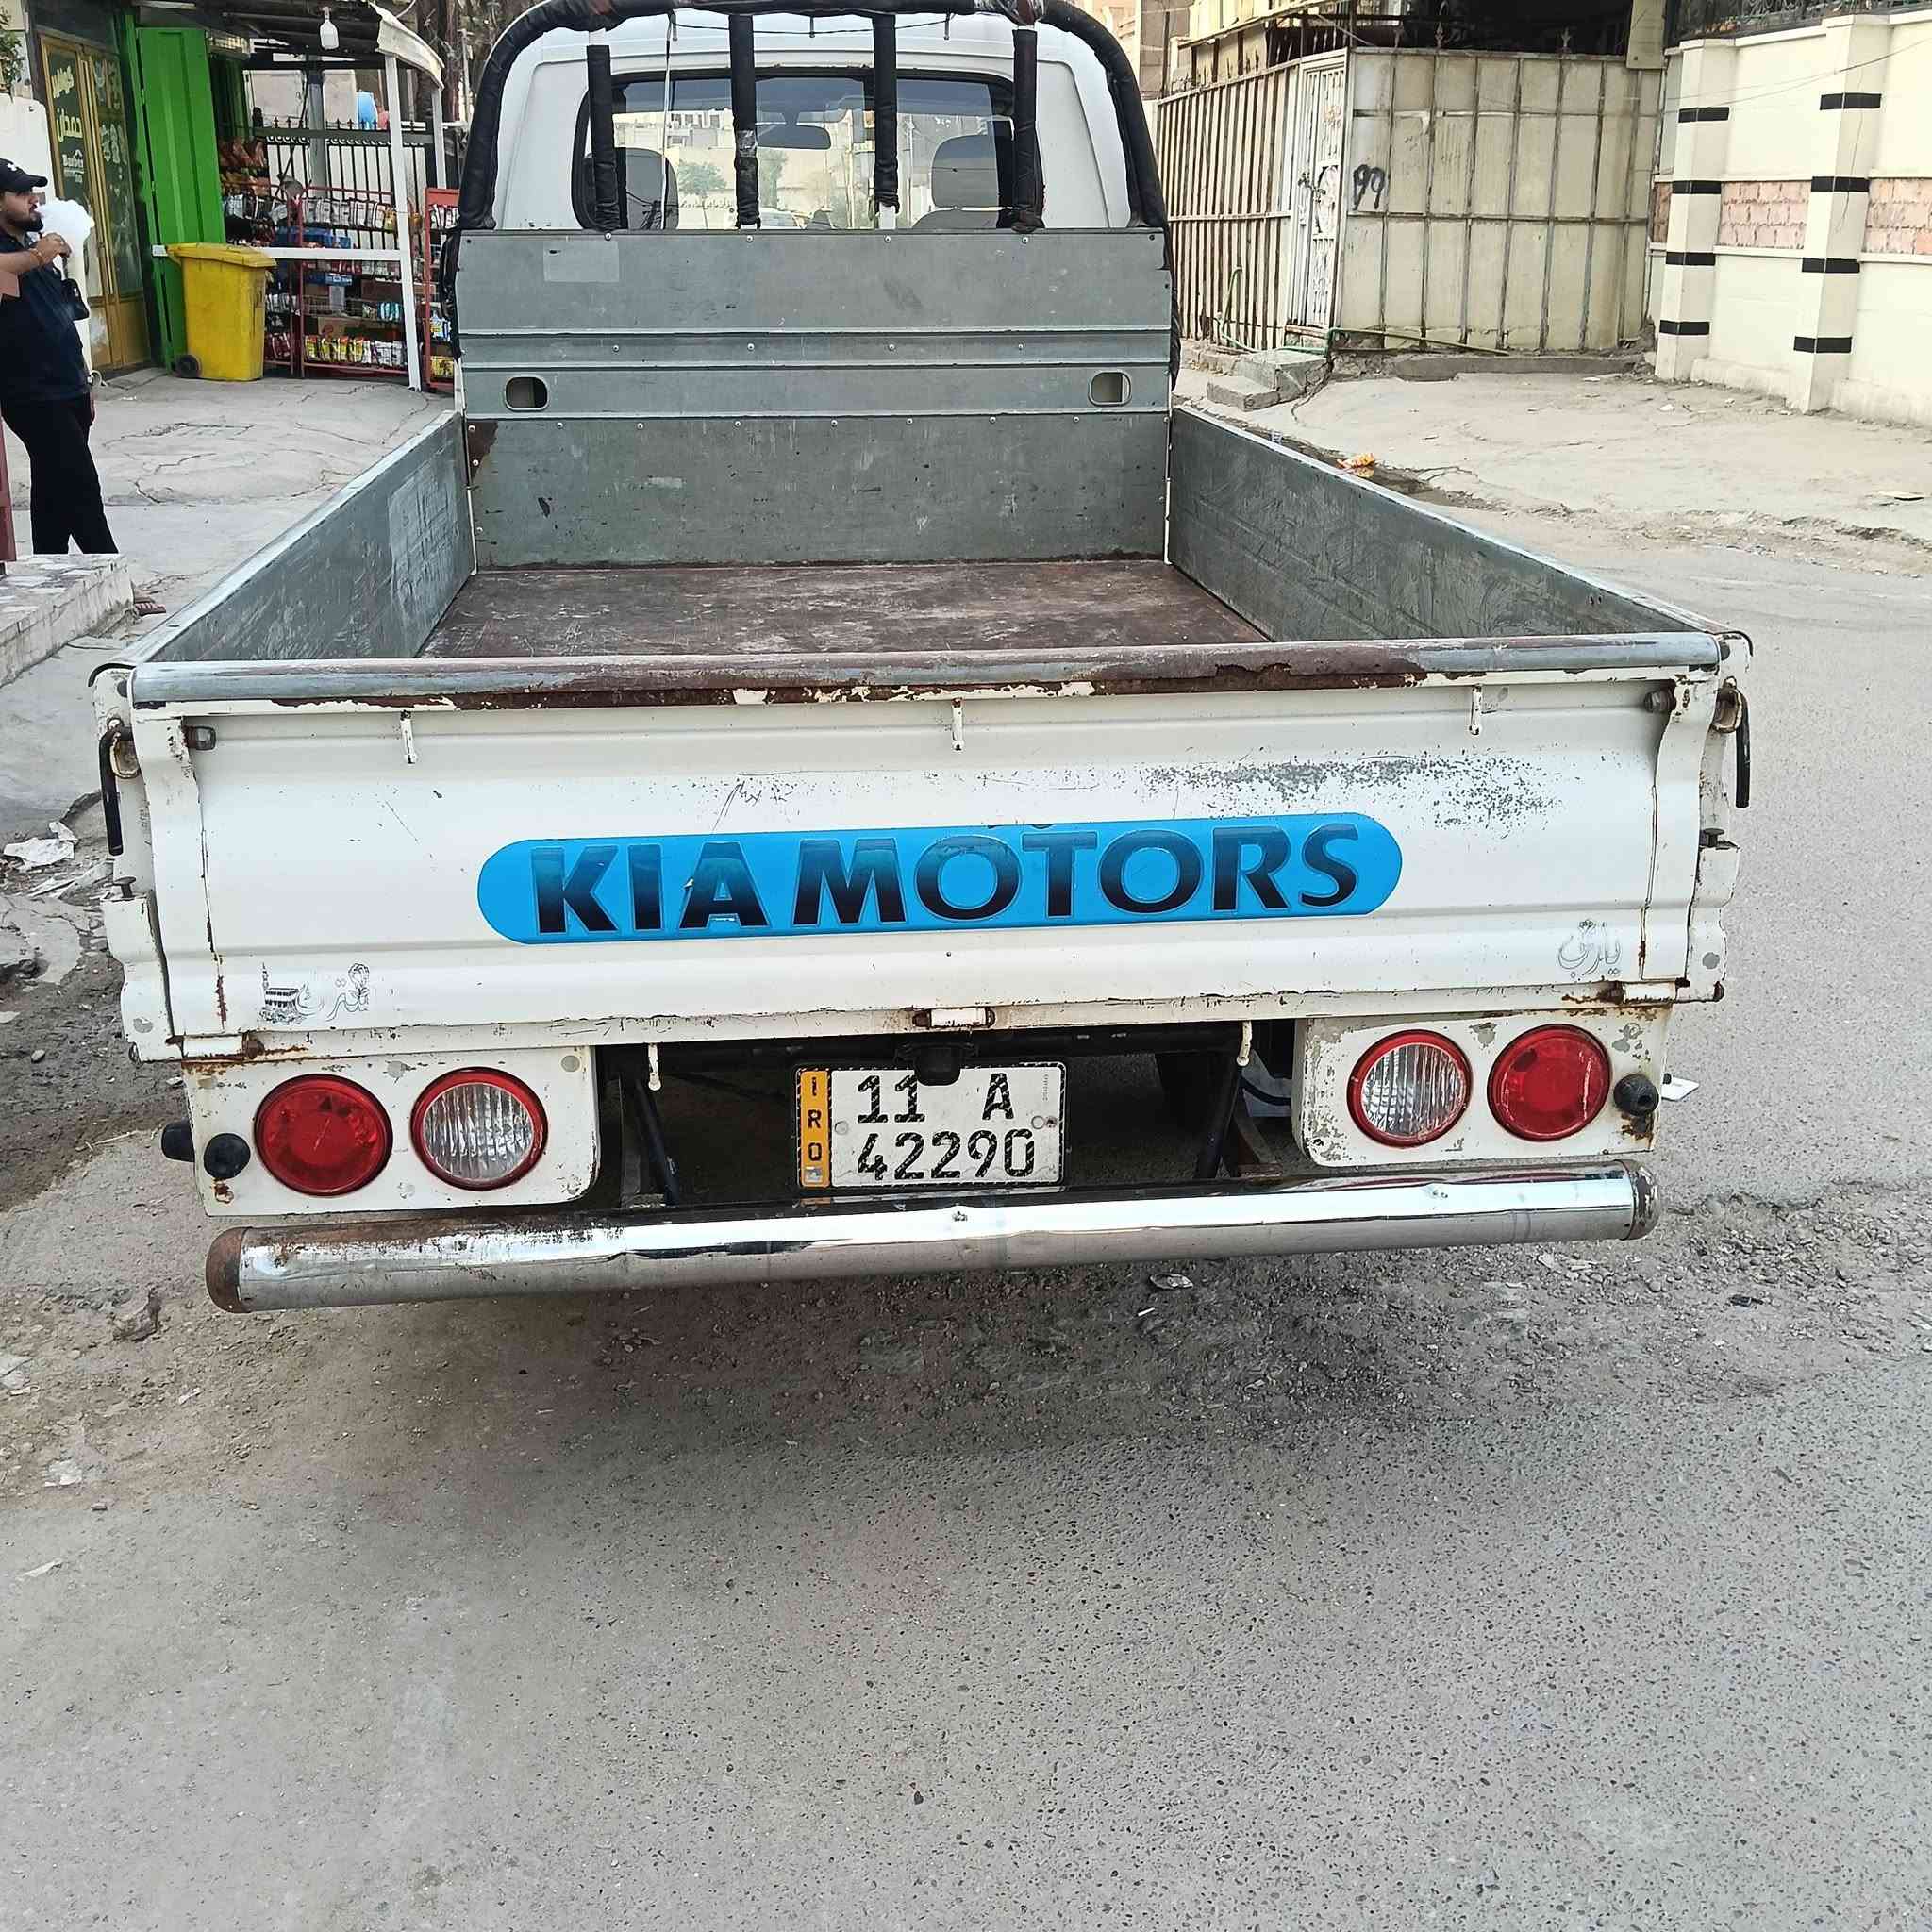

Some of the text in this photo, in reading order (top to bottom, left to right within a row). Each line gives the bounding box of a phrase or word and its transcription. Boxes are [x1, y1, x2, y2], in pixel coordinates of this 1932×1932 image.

[530, 824, 1359, 936] KIA MOTORS
[857, 1074, 925, 1124] 11
[981, 1072, 1014, 1121] A
[857, 1128, 1036, 1181] 42290
